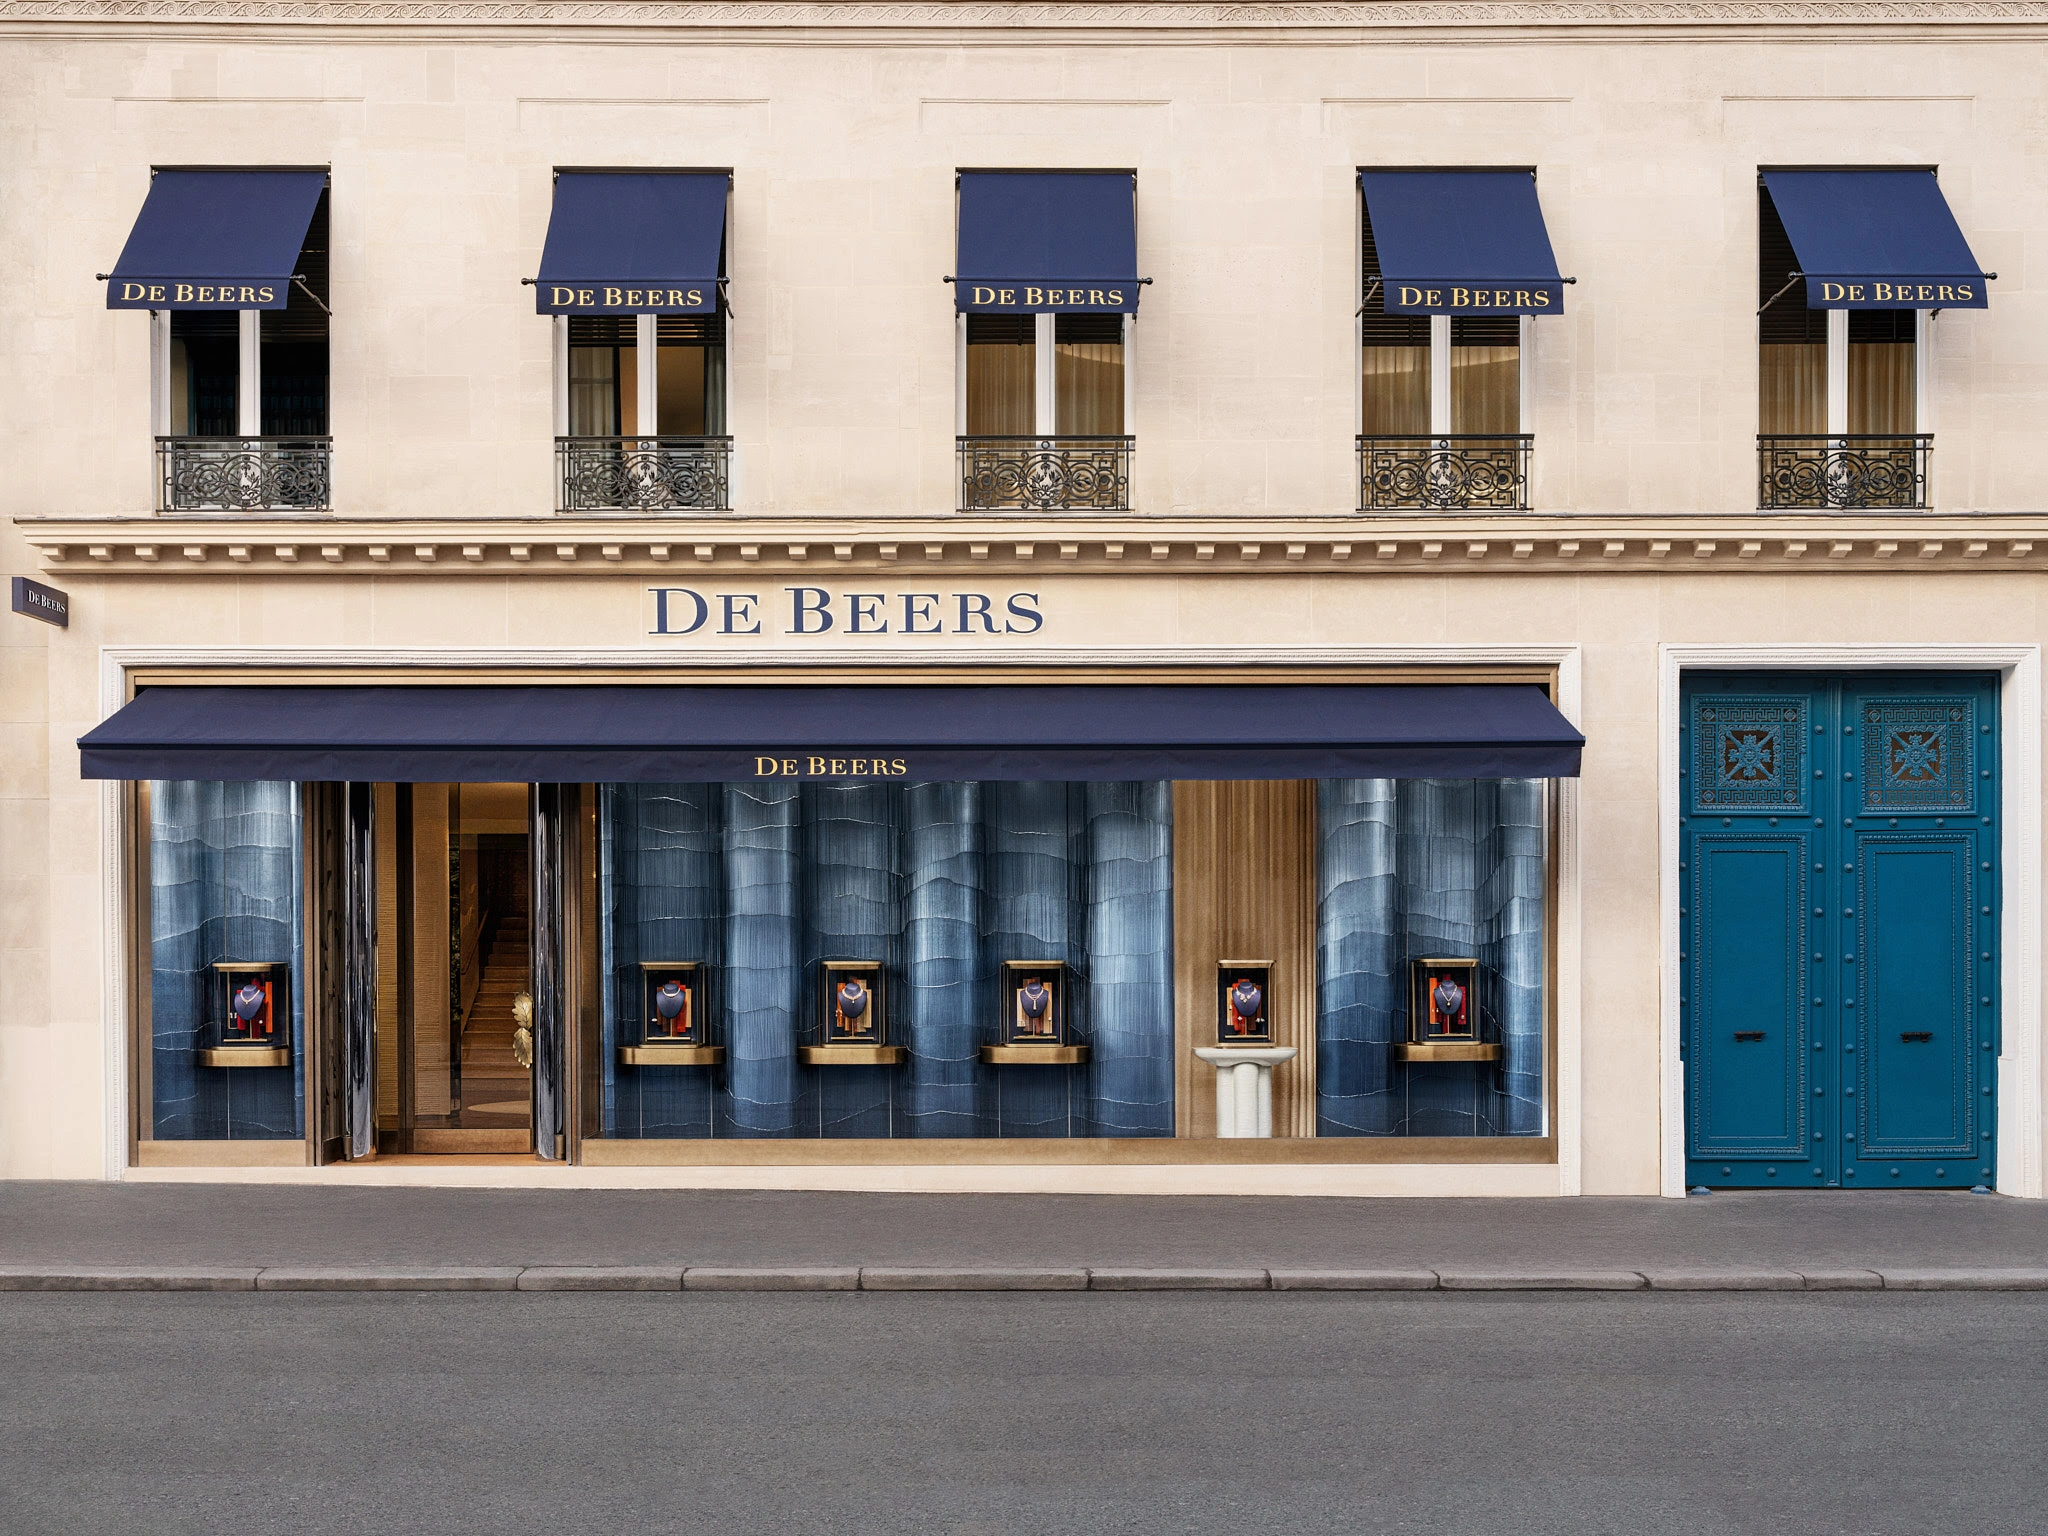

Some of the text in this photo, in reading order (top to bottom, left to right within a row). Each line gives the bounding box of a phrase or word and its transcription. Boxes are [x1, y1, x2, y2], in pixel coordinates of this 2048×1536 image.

[121, 284, 274, 302] DE BEERS
[550, 287, 703, 306] DE BEERS
[972, 287, 1123, 305] DE BEERS
[1400, 287, 1550, 306] DE BEERS
[1822, 283, 1973, 300] DE BEERS
[28, 590, 66, 614] DE BEERS
[652, 588, 1042, 634] DE BEERS
[754, 757, 907, 775] DE BEERS
